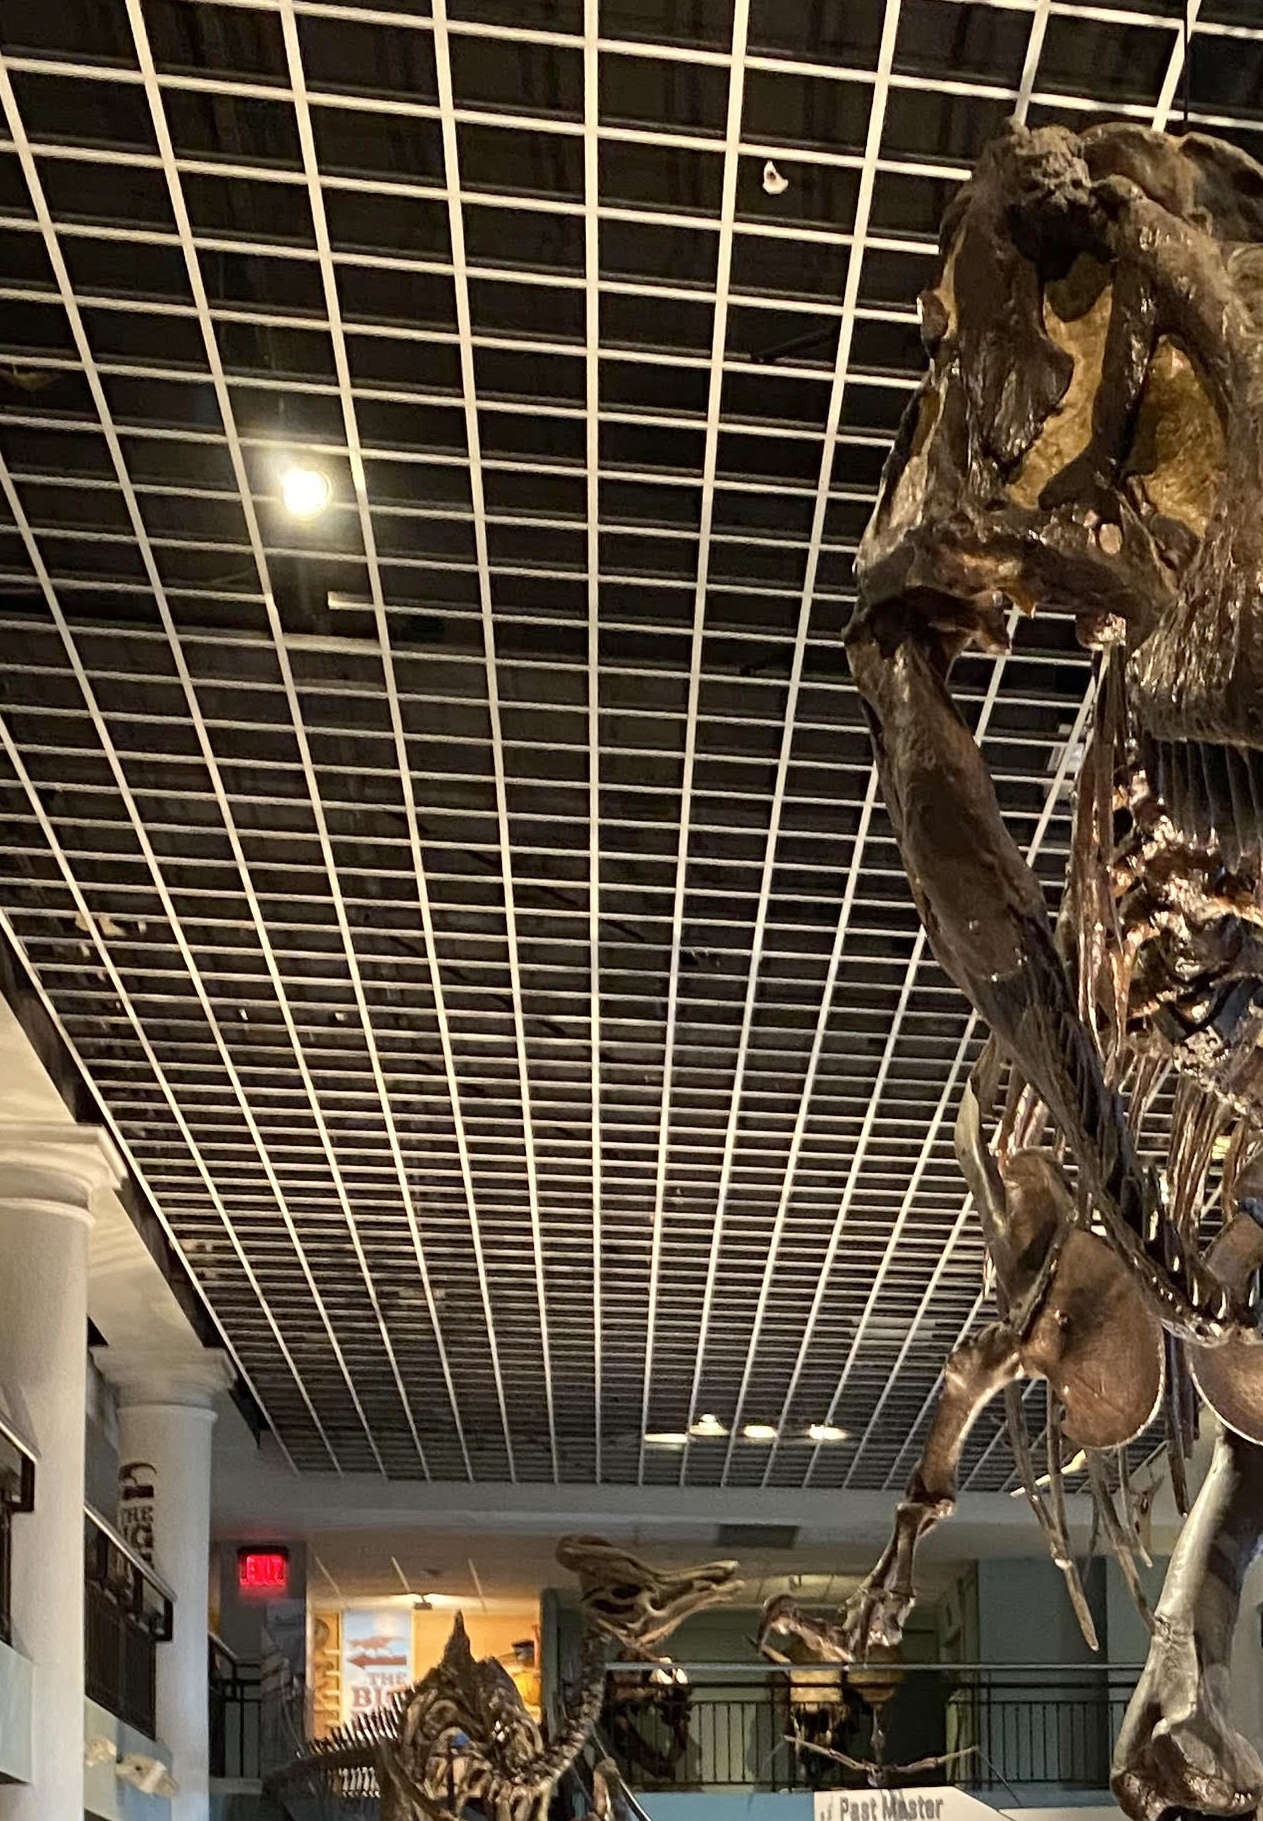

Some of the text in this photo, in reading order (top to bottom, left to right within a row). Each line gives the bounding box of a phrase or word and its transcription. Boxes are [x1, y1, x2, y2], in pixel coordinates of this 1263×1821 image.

[367, 1671, 408, 1687] THE
[840, 1794, 944, 1821] Past Master
